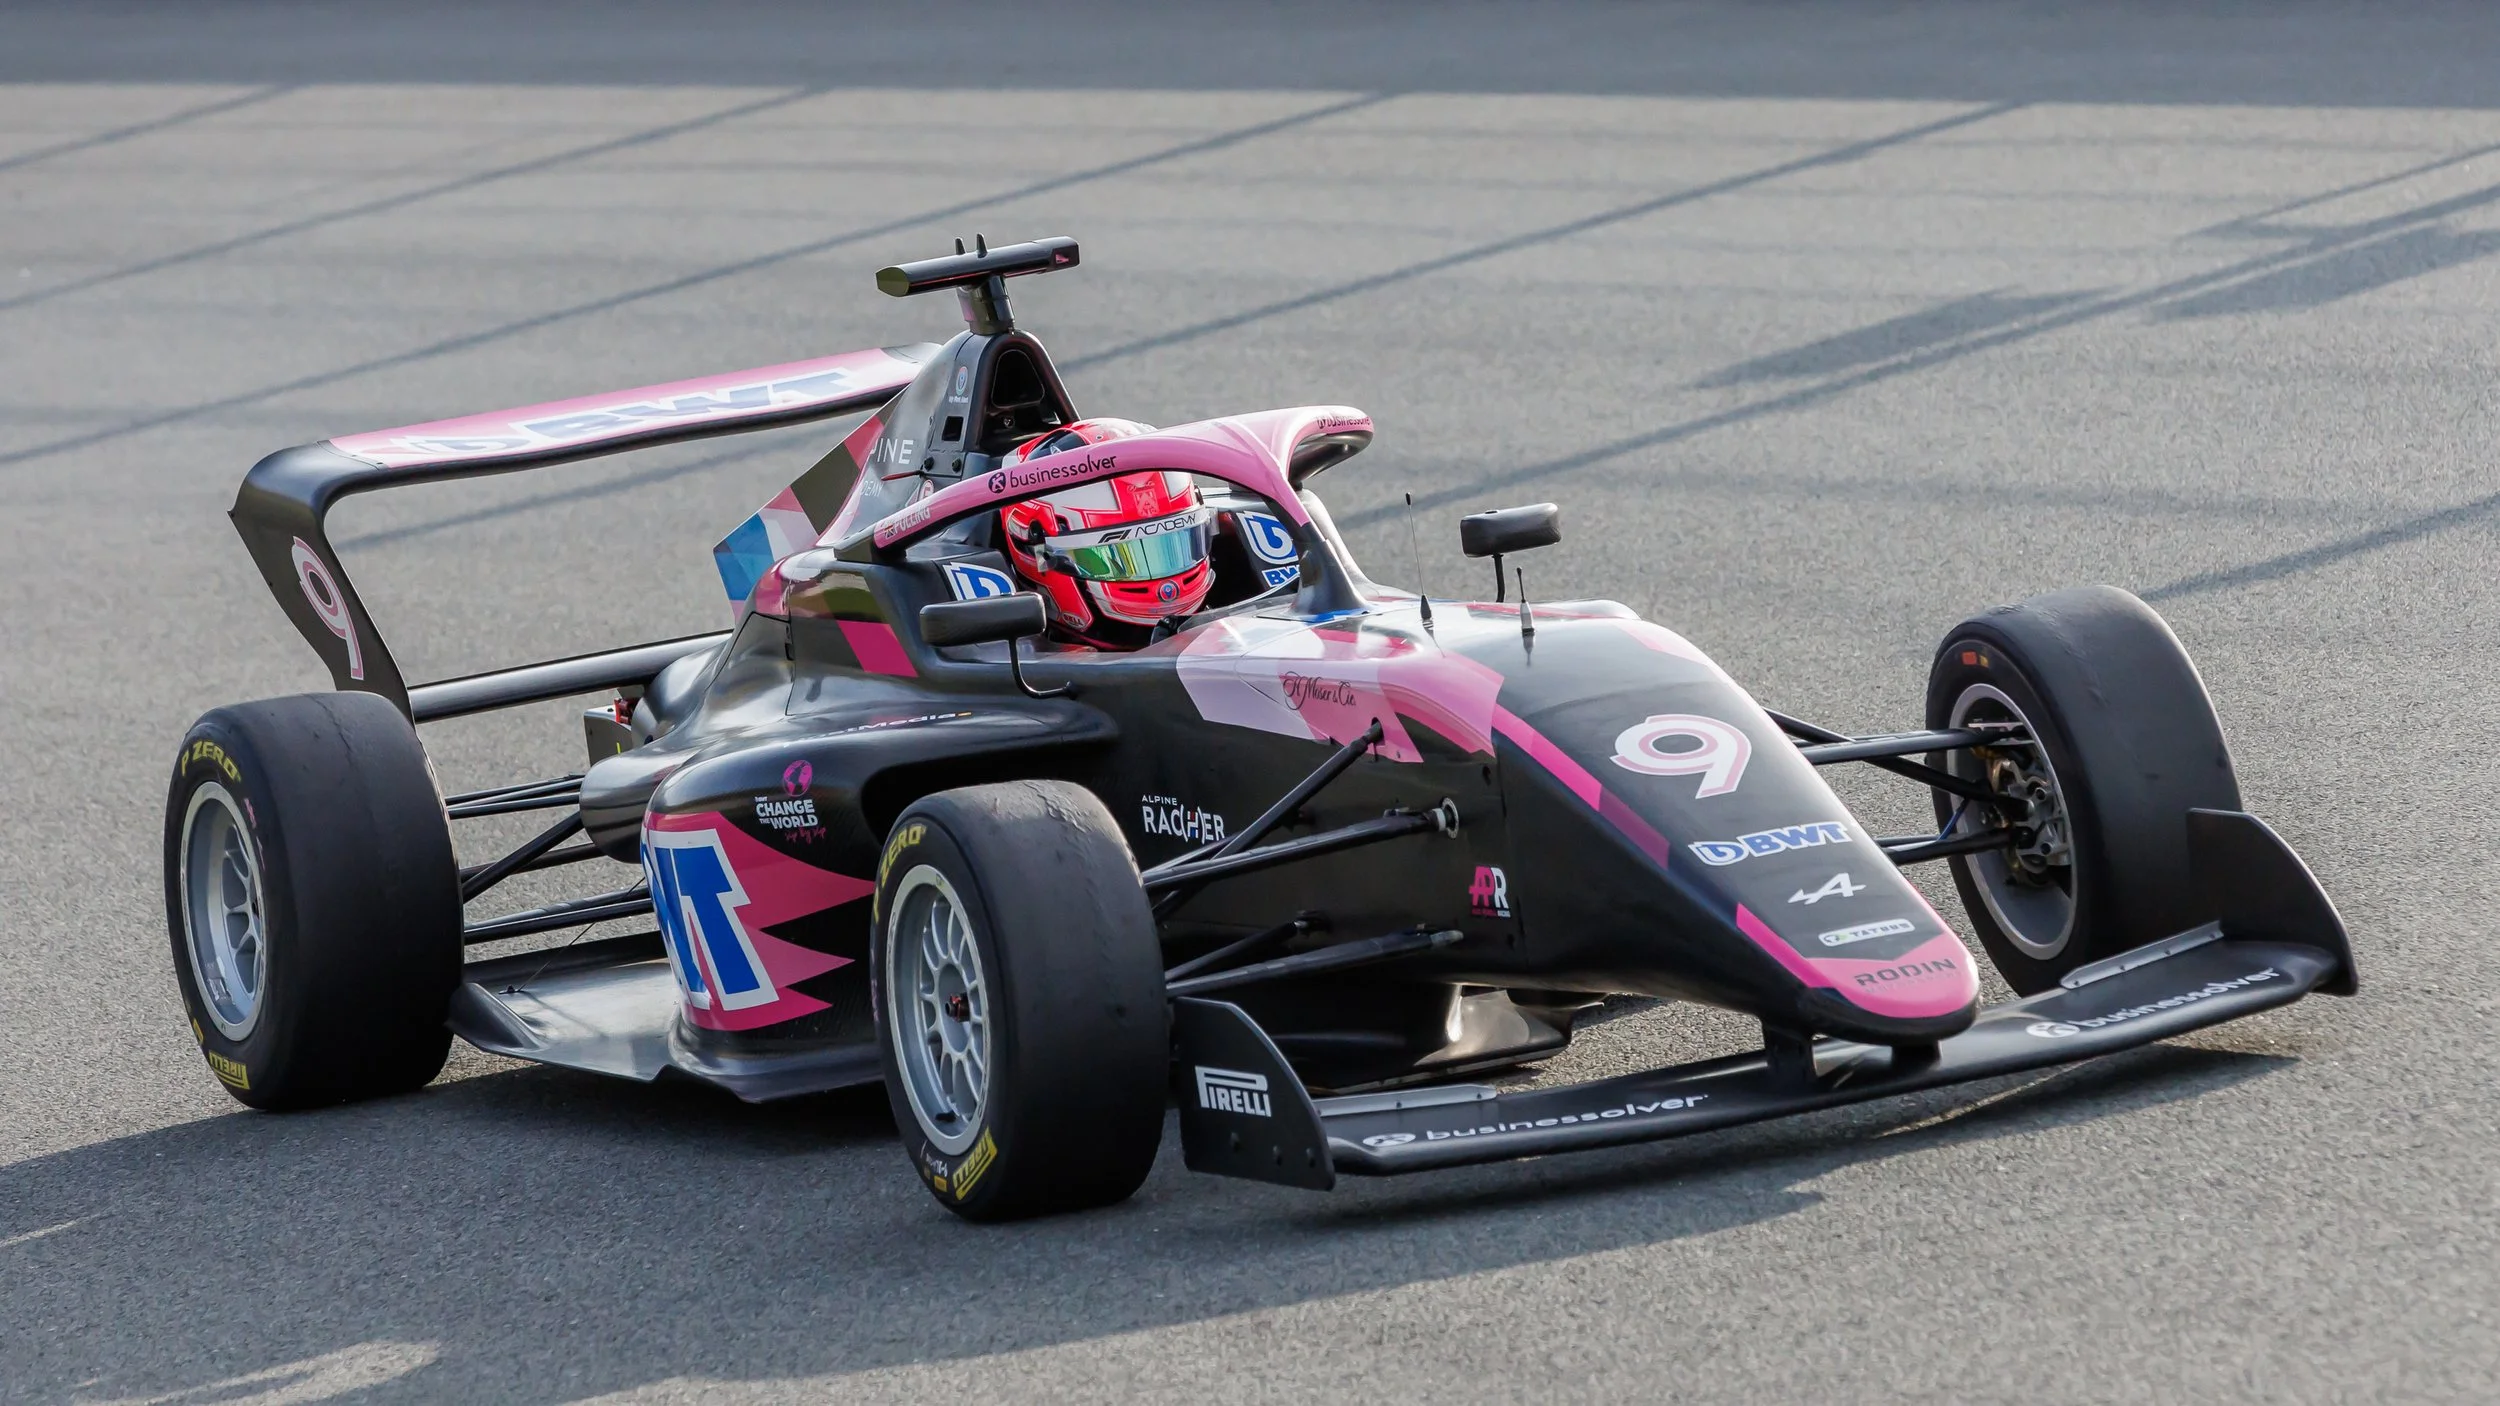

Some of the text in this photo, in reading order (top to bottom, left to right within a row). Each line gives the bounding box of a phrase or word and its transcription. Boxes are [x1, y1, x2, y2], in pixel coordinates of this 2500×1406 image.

[1010, 454, 1117, 488] businessolver
[1135, 514, 1196, 537] ACADEMY
[291, 535, 364, 681] 9
[193, 741, 236, 780] ZERO
[1609, 713, 1752, 800] 9
[756, 799, 815, 817] CHANGE
[1141, 795, 1178, 806] ALPINE
[770, 814, 818, 829] WORLD
[1736, 821, 1853, 858] BWT
[880, 825, 922, 889] ZERO
[1854, 959, 1957, 987] RODIN
[2066, 967, 2280, 1029] businessolver
[1194, 1065, 1272, 1118] PIRELLI
[1426, 1095, 1704, 1141] businessolver
[952, 1125, 998, 1201] PIRELLI
